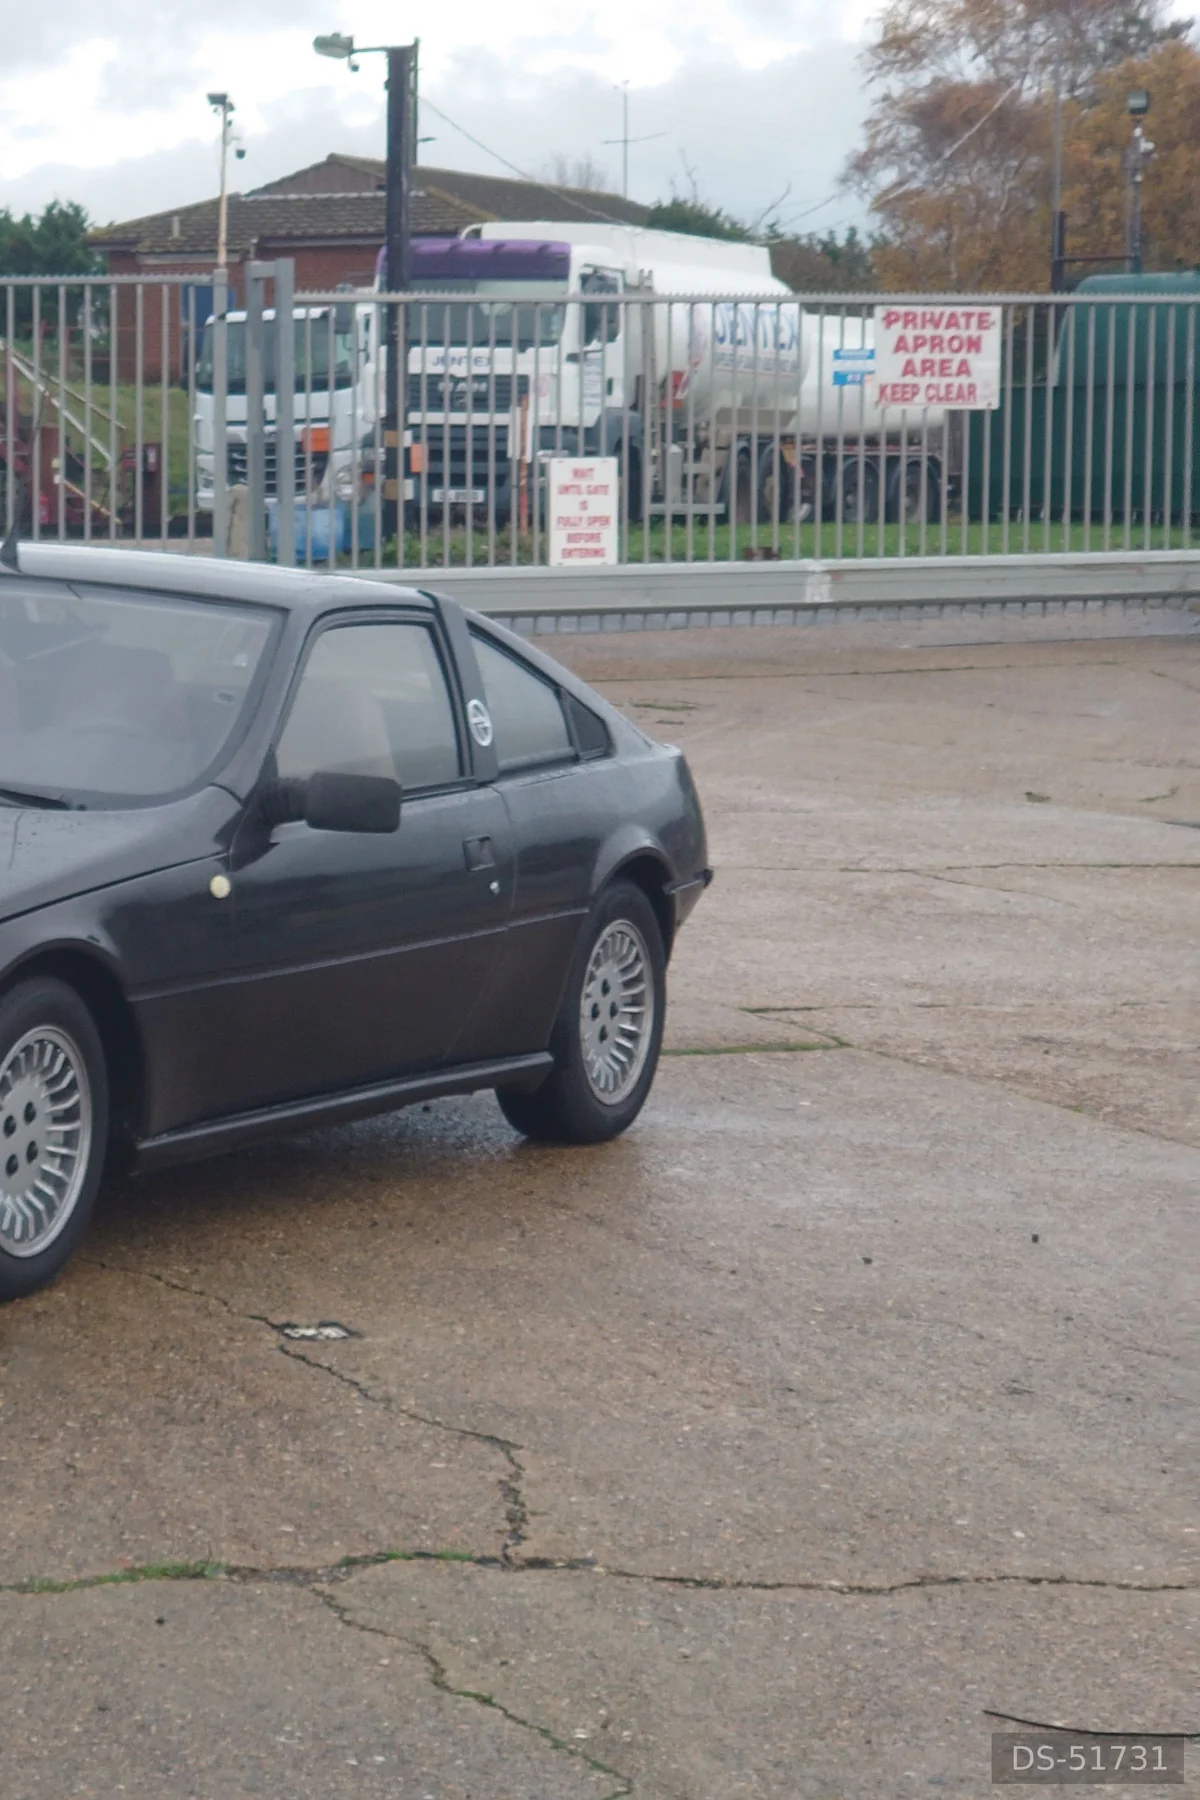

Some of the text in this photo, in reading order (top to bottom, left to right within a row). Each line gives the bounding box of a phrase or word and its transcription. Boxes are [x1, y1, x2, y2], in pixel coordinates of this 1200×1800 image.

[884, 311, 991, 330] PRIVATE
[893, 335, 982, 354] APRON
[901, 358, 971, 377] AREA
[877, 383, 977, 402] KEEP CLEAR
[586, 484, 609, 495] GATE
